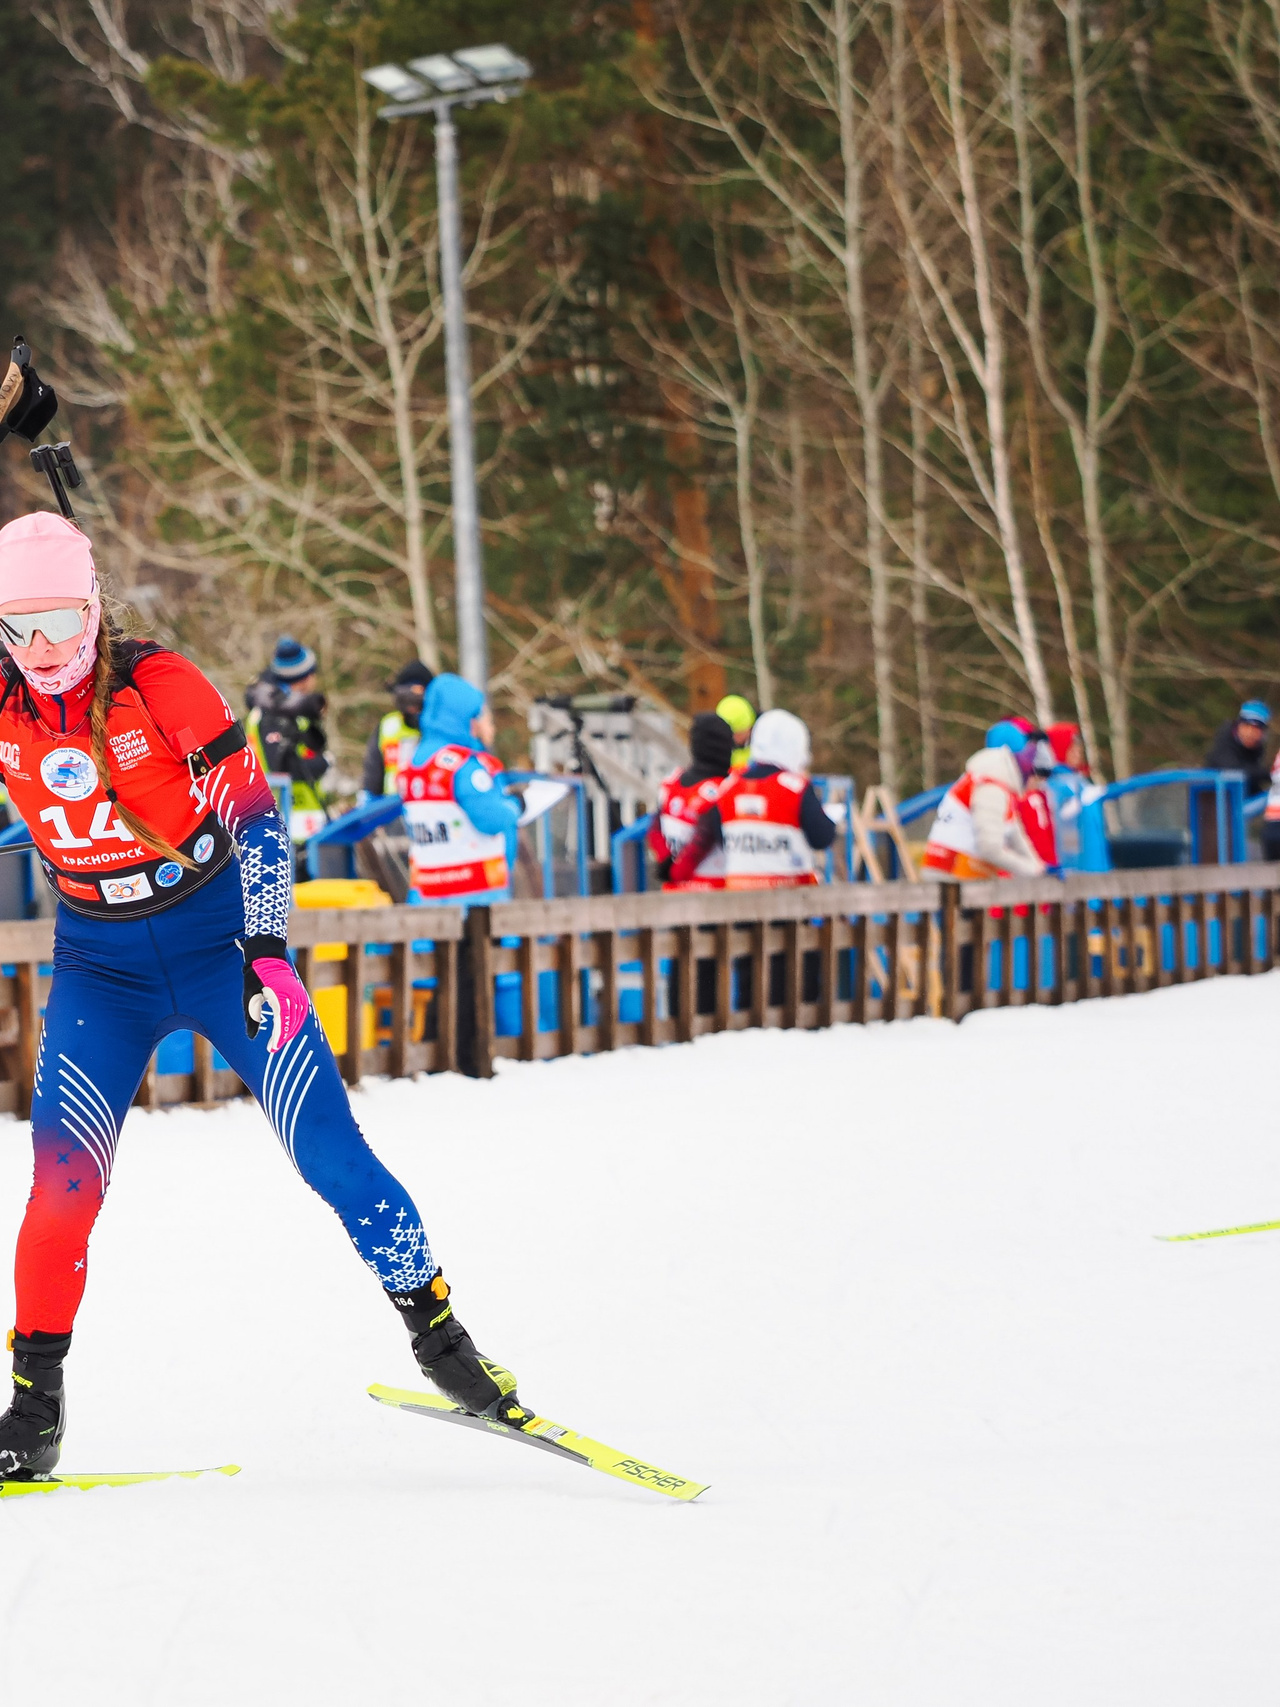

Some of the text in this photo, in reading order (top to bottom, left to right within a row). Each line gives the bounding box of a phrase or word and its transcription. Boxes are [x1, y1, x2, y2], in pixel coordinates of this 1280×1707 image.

[108, 729, 137, 746] СПОРТ
[111, 735, 147, 755] НОРМА
[115, 743, 150, 764] ЖИЗНИ
[38, 800, 135, 849] 14
[62, 846, 145, 867] КРАСНОЯРСК
[394, 1297, 415, 1307] 164
[612, 1458, 687, 1492] FISCHER
